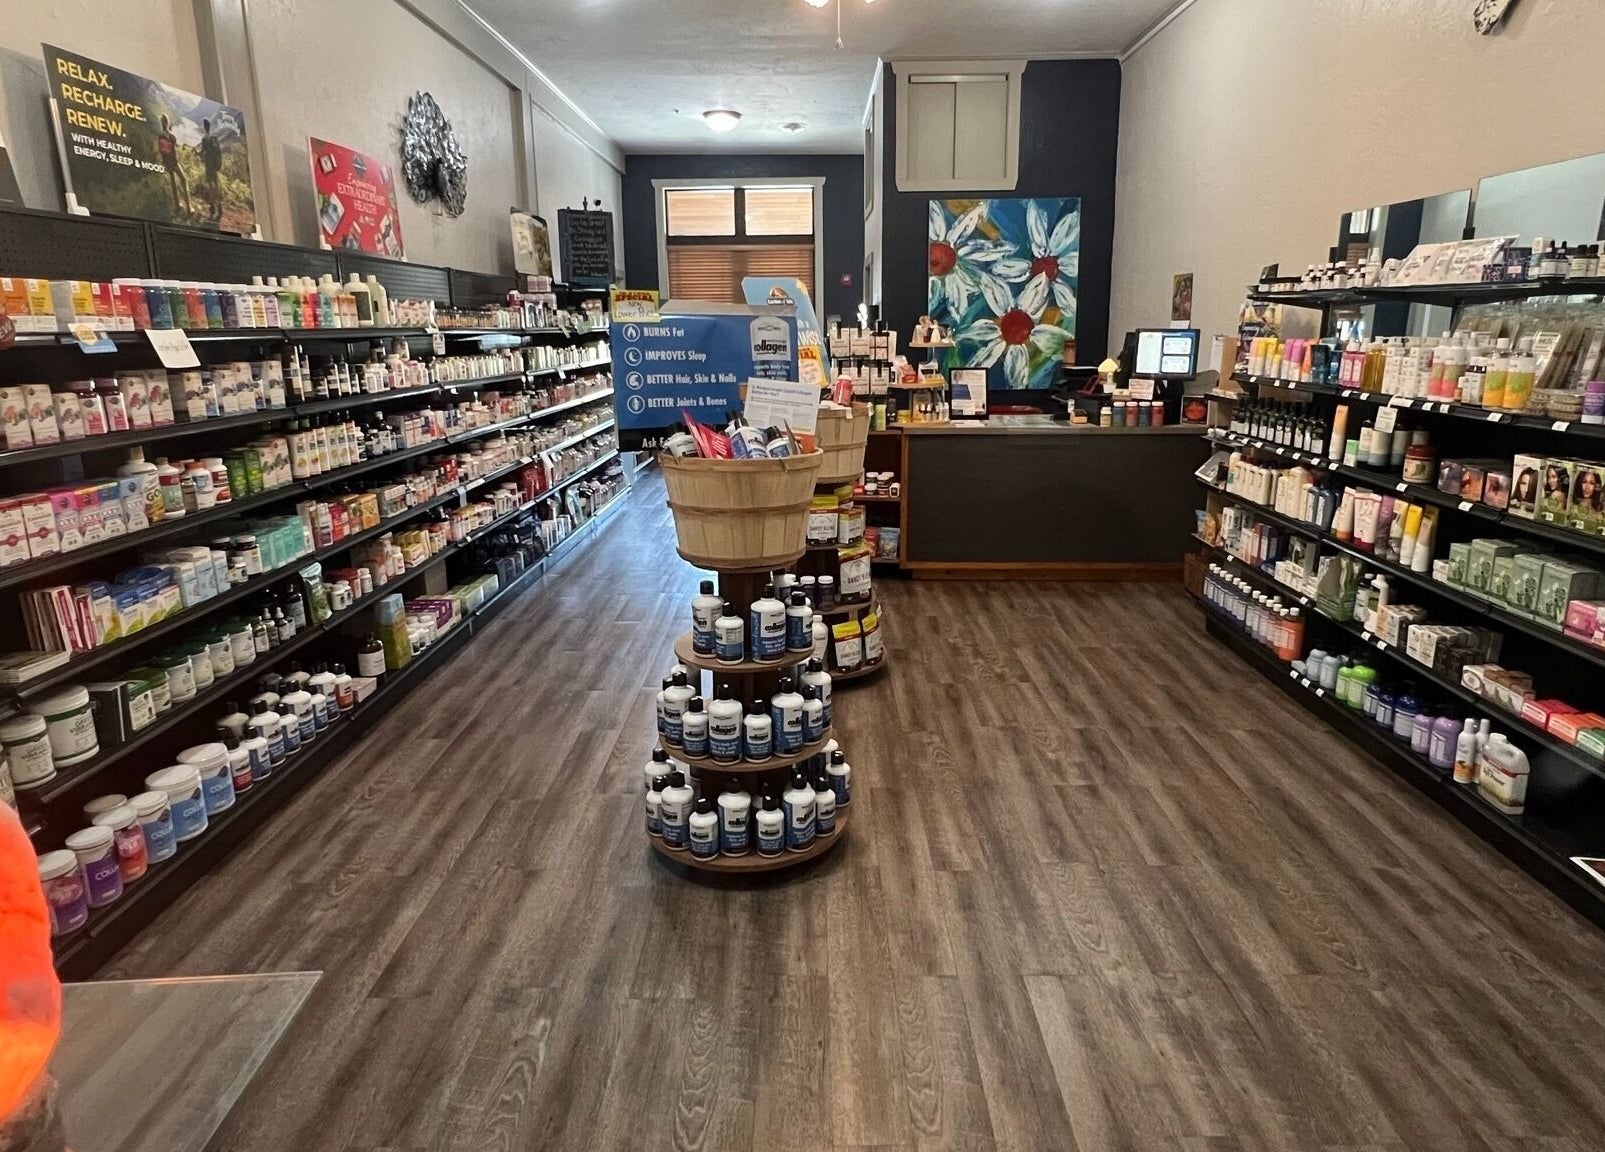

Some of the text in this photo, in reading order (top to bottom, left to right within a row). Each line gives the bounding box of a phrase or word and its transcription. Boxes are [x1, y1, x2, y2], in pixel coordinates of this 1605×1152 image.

[56, 57, 113, 90] RELAX.
[61, 83, 147, 122] RECHARGE.
[66, 108, 127, 138] RENEW.
[71, 132, 132, 155] WITH HEALTHY
[73, 145, 166, 173] ENERGY, SLEEP & MOOD
[643, 327, 685, 337] BURNS Fat
[753, 339, 788, 355] collagen
[645, 350, 707, 363] IMPROVES Sleep
[646, 372, 737, 385] BETTER Hair, Skin & Nails
[647, 396, 728, 408] BETTER Joints & Bones
[642, 437, 659, 449] Ask
[711, 725, 737, 735] collagen
